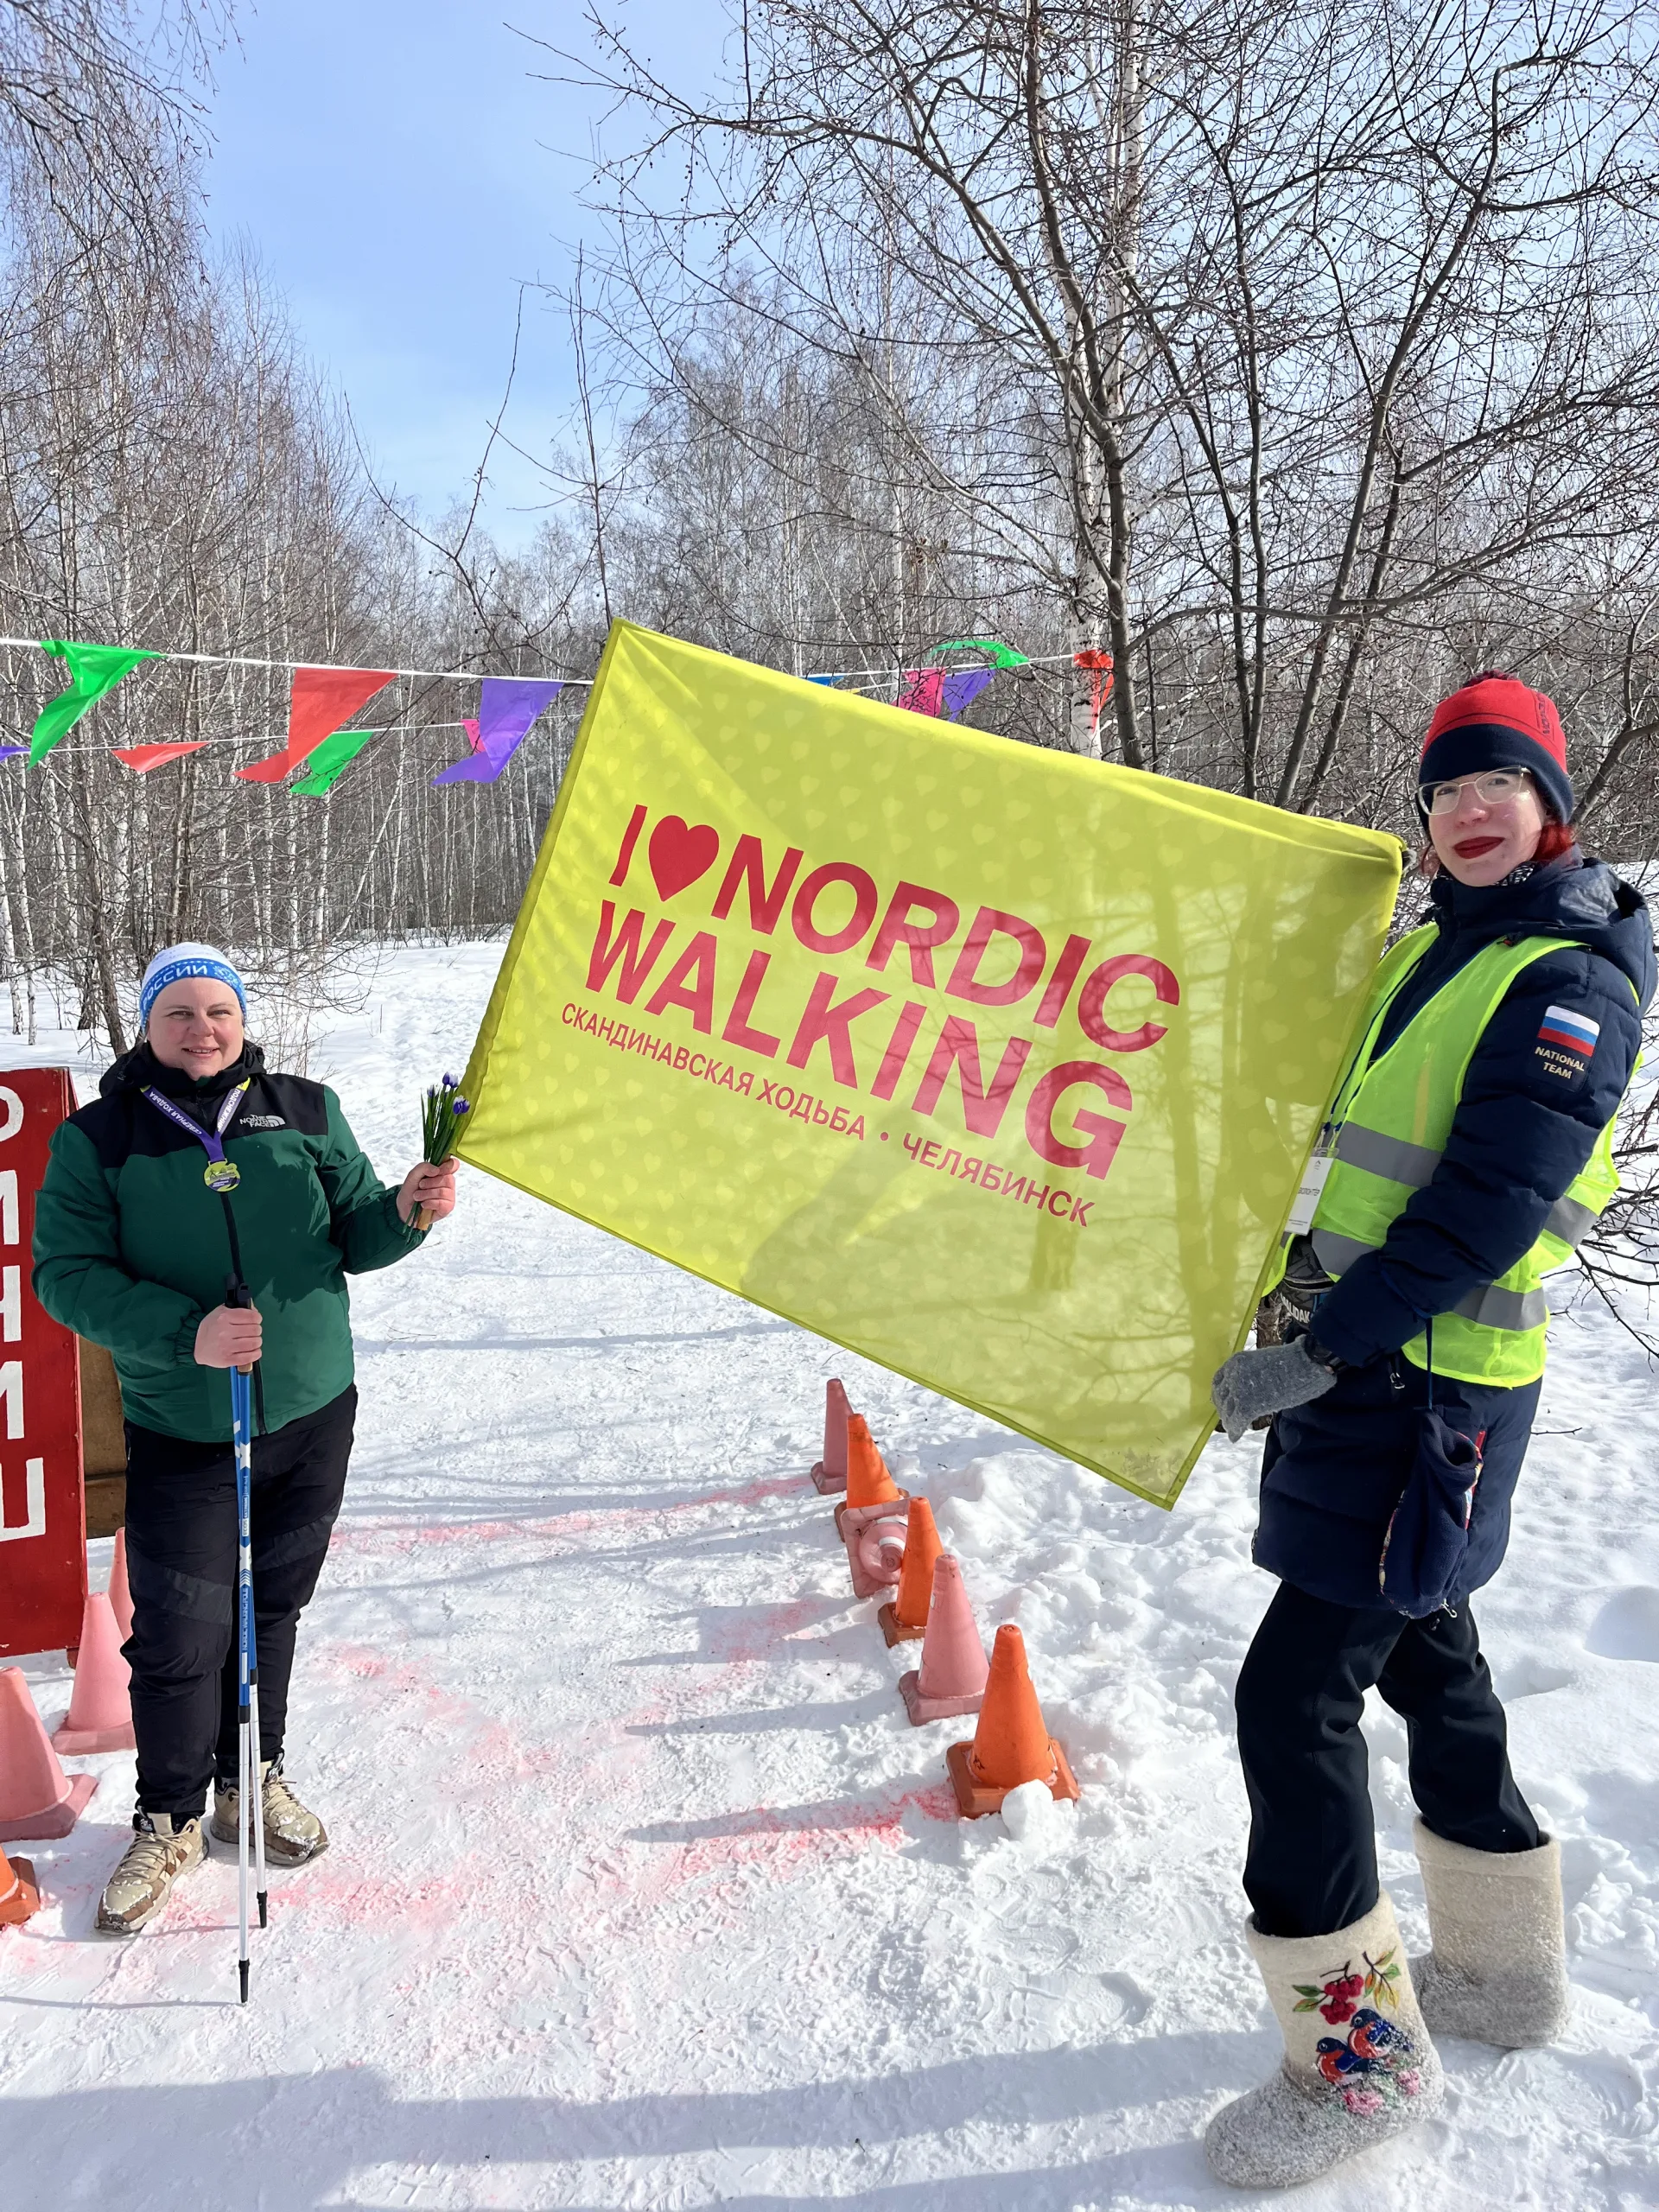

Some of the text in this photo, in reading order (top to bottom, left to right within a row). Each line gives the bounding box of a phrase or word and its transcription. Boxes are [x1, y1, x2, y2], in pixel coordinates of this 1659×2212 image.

[609, 804, 1180, 1053] I NORDIC
[586, 900, 1133, 1180] WALKING
[1535, 1046, 1585, 1071] NATIONAL
[1542, 1061, 1573, 1079] TEAM
[149, 1090, 203, 1135] СЕВЕРНАЯ ХОДЬБА
[562, 1002, 1094, 1227] СКАНДИНАВСКАЯ ХОДЬБА ЧЕЛЯБИНСК
